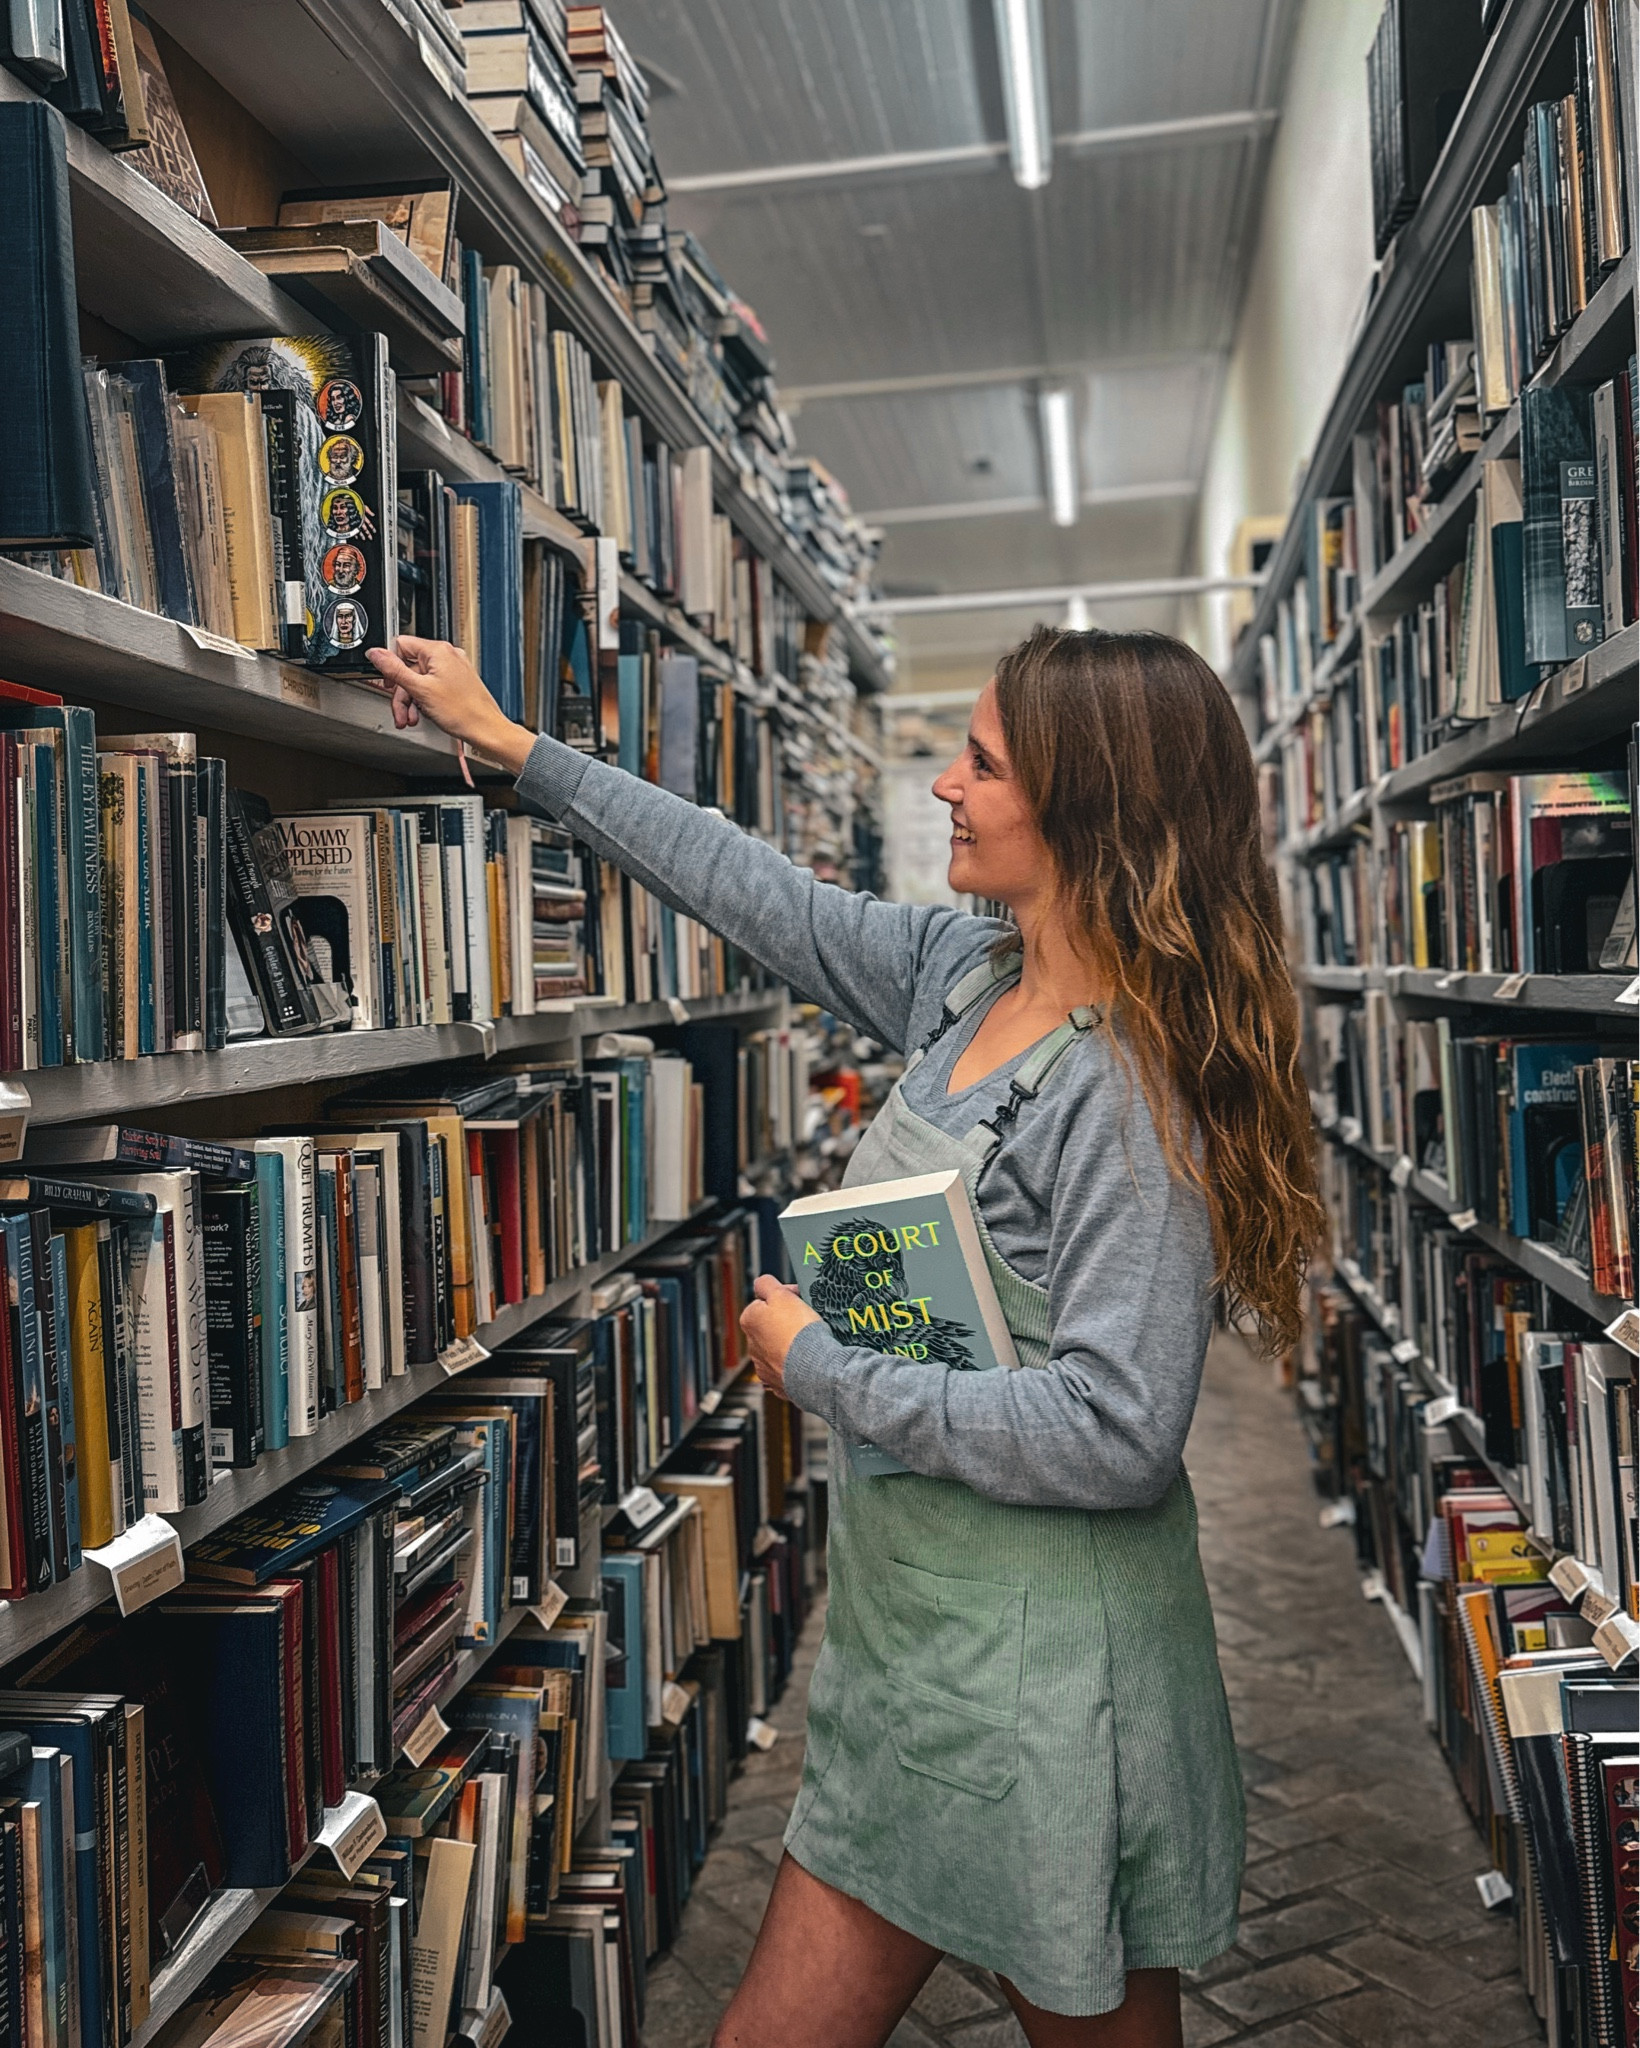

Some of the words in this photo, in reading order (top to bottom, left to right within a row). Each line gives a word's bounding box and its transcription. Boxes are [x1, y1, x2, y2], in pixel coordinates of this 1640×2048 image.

[283, 678, 319, 698] CHRISTIAN
[81, 742, 95, 778] THE
[140, 778, 148, 817] PLAIN
[60, 804, 68, 856] COMMANDER
[83, 783, 98, 894] EYEWITNESS
[275, 822, 350, 848] MOMMY
[378, 820, 387, 872] THRIVING
[143, 859, 150, 880] ON
[233, 821, 245, 841] Don't
[240, 843, 251, 863] Have
[247, 864, 262, 889] Enough
[284, 847, 353, 866] PPLESEED
[291, 866, 315, 876] Planting
[315, 866, 324, 877] for
[324, 866, 333, 874] the
[333, 865, 353, 875] Future
[236, 866, 255, 905] ATHEIST
[86, 910, 94, 953] RONALDS
[381, 886, 389, 936] COLLEGE
[117, 909, 125, 960] CHRISTIAN
[117, 963, 125, 1022] PERSPECTIVE
[265, 945, 279, 969] Geisler
[273, 978, 288, 998] Turek
[121, 1144, 149, 1160] Surviving
[149, 1149, 161, 1161] Soul
[145, 1133, 159, 1147] Soup
[159, 1136, 168, 1148] for
[298, 1143, 314, 1186] QUIET
[44, 1184, 61, 1199] BILLY
[62, 1186, 92, 1202] GRAHAM
[167, 1223, 174, 1244] 90
[183, 1186, 197, 1266] HOW
[203, 1223, 230, 1232] work?
[301, 1194, 314, 1267] TRIUMPHS
[803, 1240, 824, 1265] A
[832, 1221, 940, 1261] COURT
[19, 1235, 32, 1281] HIGH
[276, 1254, 286, 1284] Stage
[864, 1269, 893, 1289] OF
[56, 1249, 66, 1318] Wednesdays
[167, 1252, 177, 1326] MINUTES
[22, 1286, 37, 1363] CALLING
[87, 1299, 99, 1353] AGAIN
[115, 1304, 125, 1316] A
[246, 1290, 254, 1340] MATTERS
[305, 1315, 315, 1341] Mary
[847, 1296, 933, 1335] MIST
[45, 1309, 59, 1386] Jumped
[59, 1319, 67, 1347] were
[116, 1322, 127, 1359] LIFE
[171, 1333, 178, 1350] IN
[306, 1341, 315, 1362] Alice
[60, 1349, 70, 1384] pretty
[307, 1362, 315, 1399] Williams
[63, 1385, 73, 1427] normal
[172, 1357, 181, 1422] HEAVEN
[34, 1421, 47, 1469] EVELYN
[121, 1427, 132, 1483] LIVING
[175, 1436, 184, 1476] PIPER
[493, 1428, 501, 1482] OPERATION
[30, 1454, 38, 1489] DONNA
[32, 1491, 41, 1541] VANLIERE
[37, 1473, 49, 1537] HUSBAND
[351, 1595, 358, 1609] TO
[351, 1660, 359, 1702] HEALTH
[117, 1710, 125, 1749] TENNEY
[117, 1766, 127, 1823] SECRET
[15, 1822, 23, 1909] HITCHCOCK
[119, 1831, 129, 1900] SOURCES
[121, 1908, 130, 1926] OF
[122, 1933, 131, 1987] POWER
[378, 1940, 390, 2002] Articles
[18, 1980, 26, 2036] MOONS
[379, 2003, 389, 2021] of
